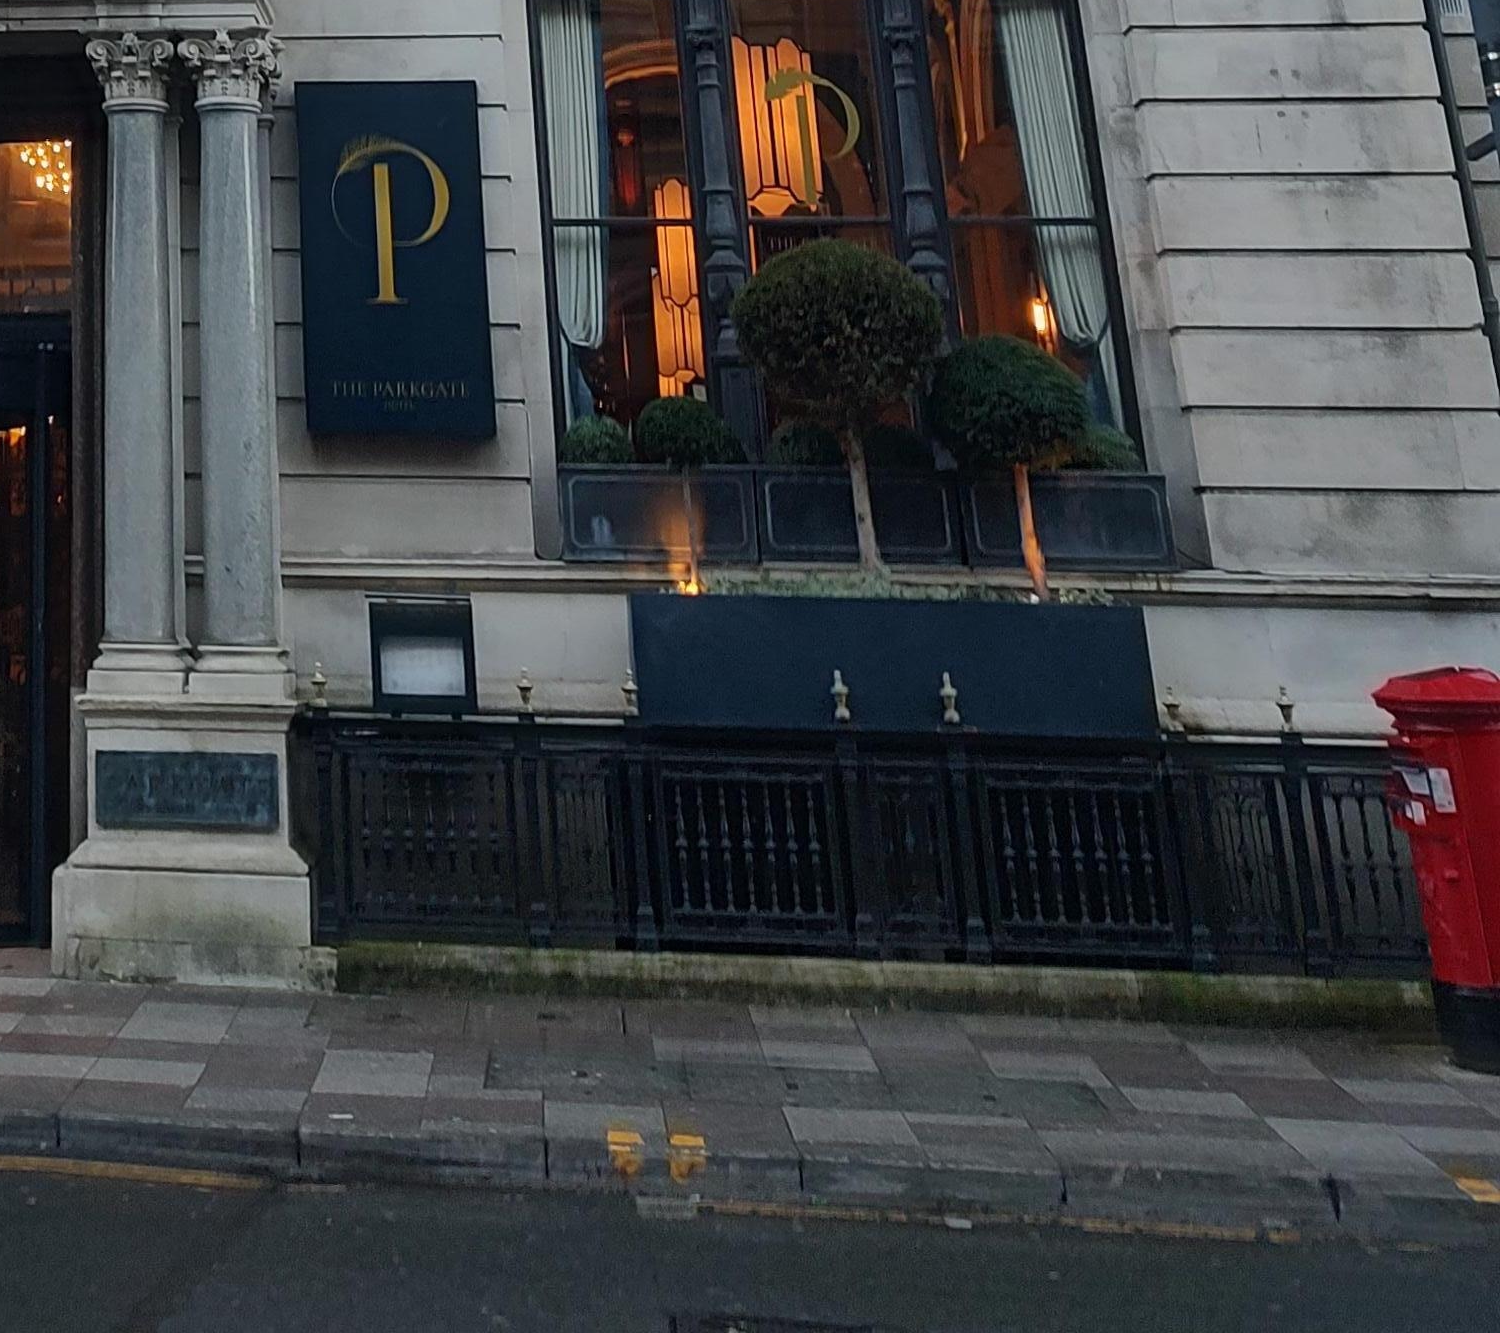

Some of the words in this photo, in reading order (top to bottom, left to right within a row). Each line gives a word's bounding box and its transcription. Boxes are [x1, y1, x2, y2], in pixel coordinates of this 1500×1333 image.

[331, 133, 451, 307] P
[332, 380, 367, 398] THE
[373, 380, 470, 399] PARKGATE
